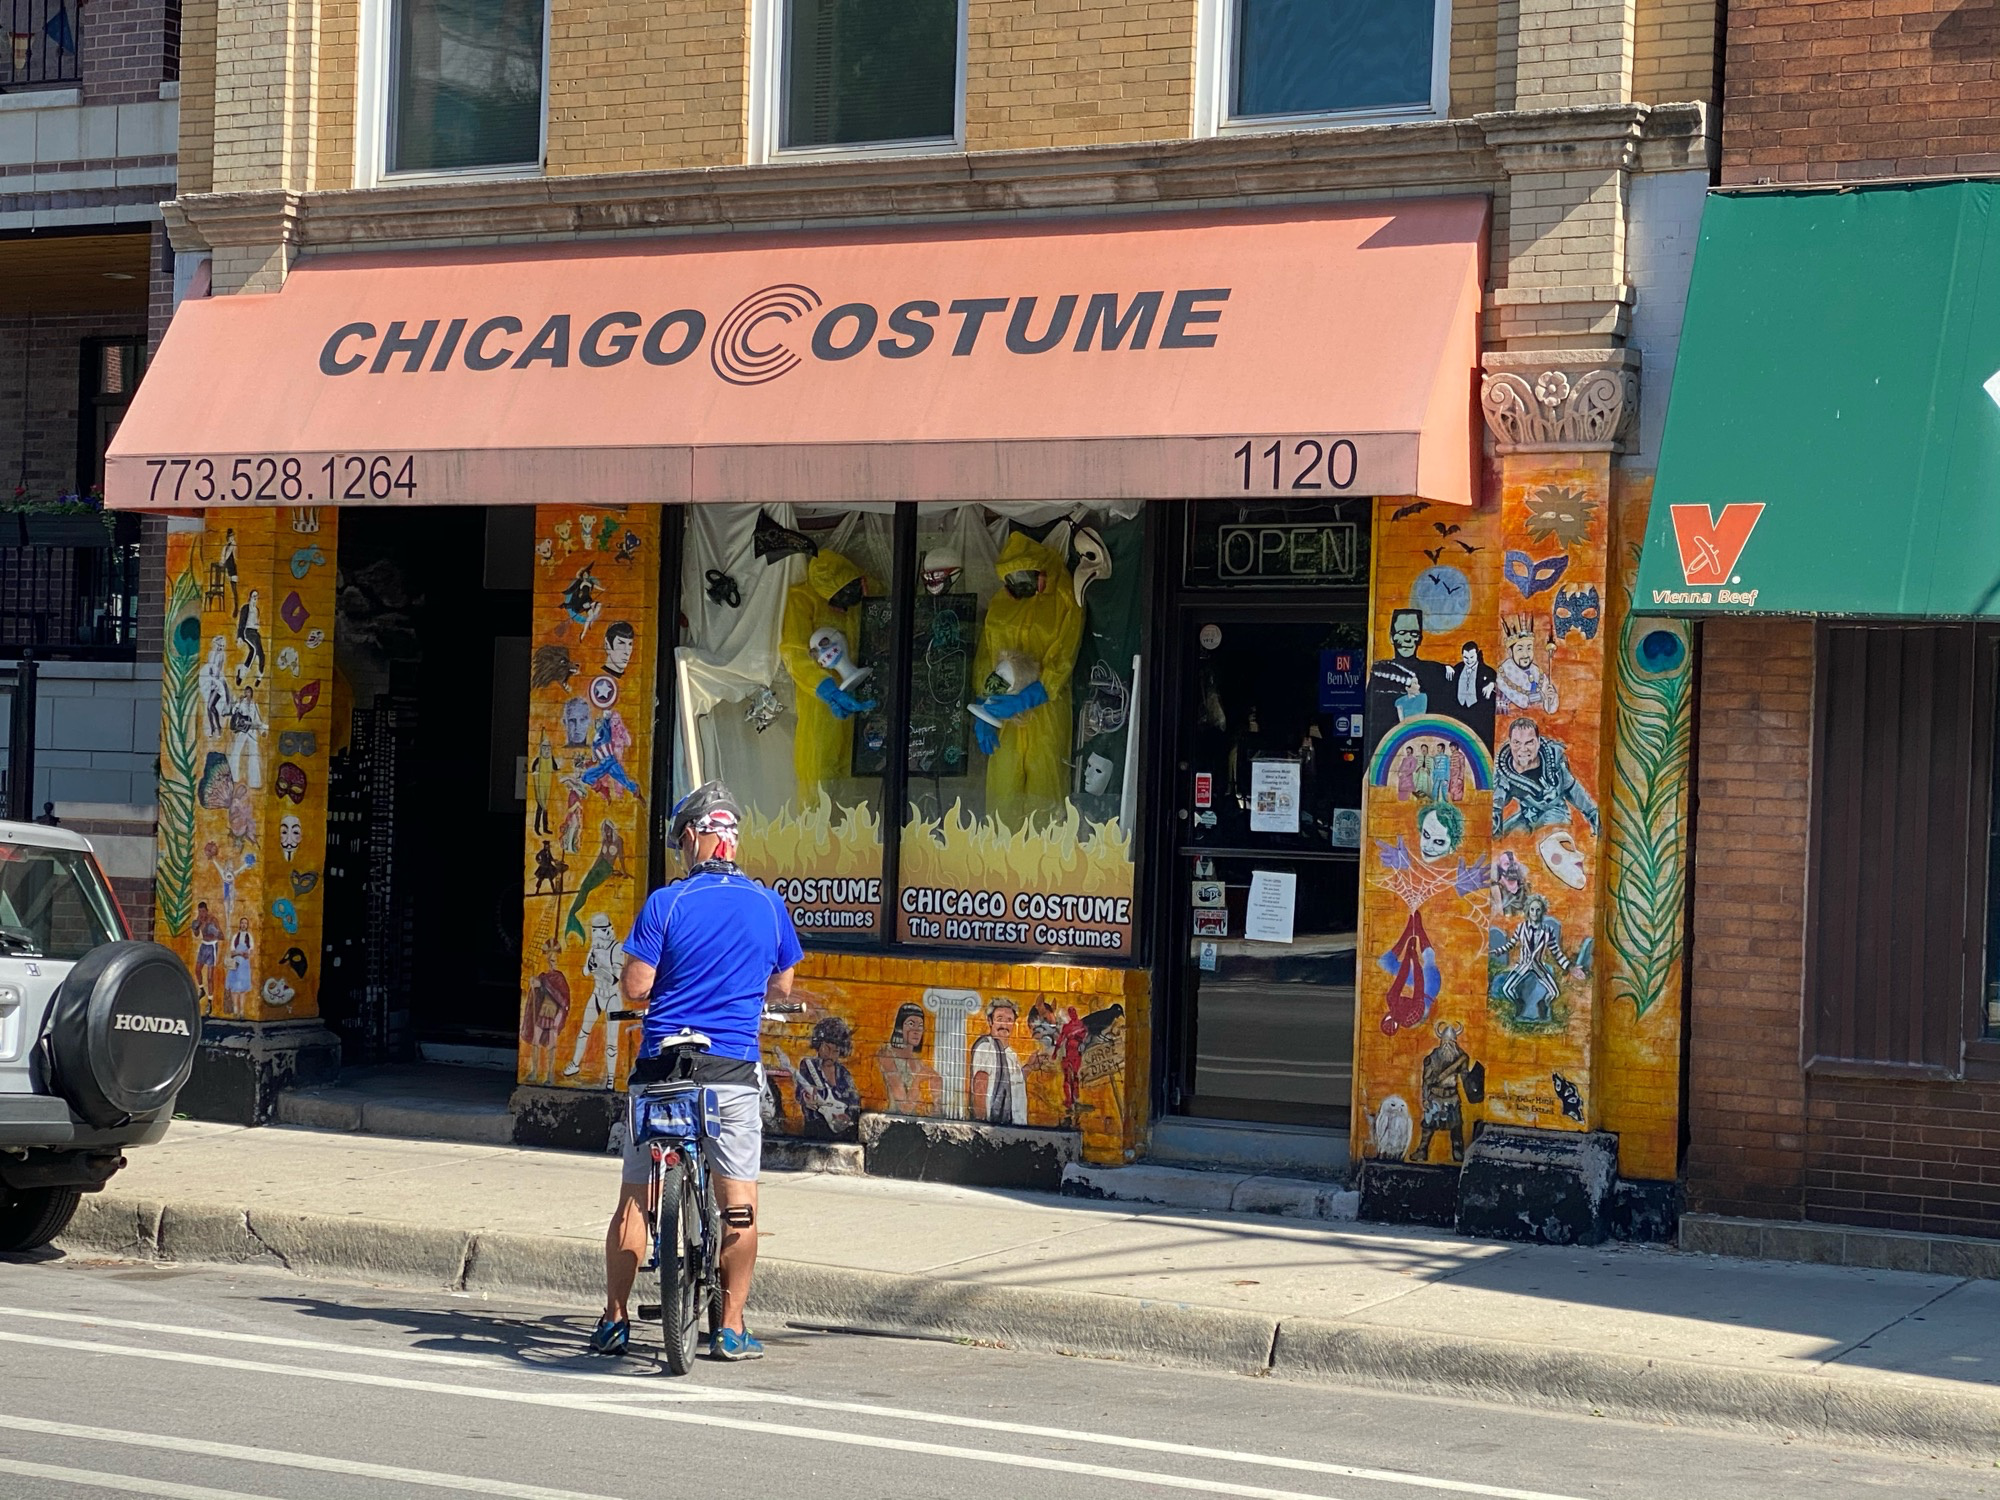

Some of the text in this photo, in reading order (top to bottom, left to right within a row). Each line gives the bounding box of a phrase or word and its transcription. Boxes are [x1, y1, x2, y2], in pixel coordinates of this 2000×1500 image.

[318, 283, 1232, 386] CHICAGO COSTUME
[1234, 439, 1358, 490] 1120
[145, 455, 418, 502] 773.528.1264
[1224, 527, 1350, 575] OPEN
[1652, 589, 1759, 607] Vienna Beef
[1336, 656, 1351, 671] BN
[1326, 671, 1360, 689] Ben Nye
[773, 877, 882, 904] COSTUME
[793, 907, 874, 928] Costumes
[901, 887, 1132, 925] CHICAGO COSTUME
[908, 917, 1122, 948] The HOTTEST Costumes
[114, 1013, 190, 1037] HONDA
[1084, 1046, 1118, 1064] CARPE
[1090, 1059, 1117, 1075] DIEM
